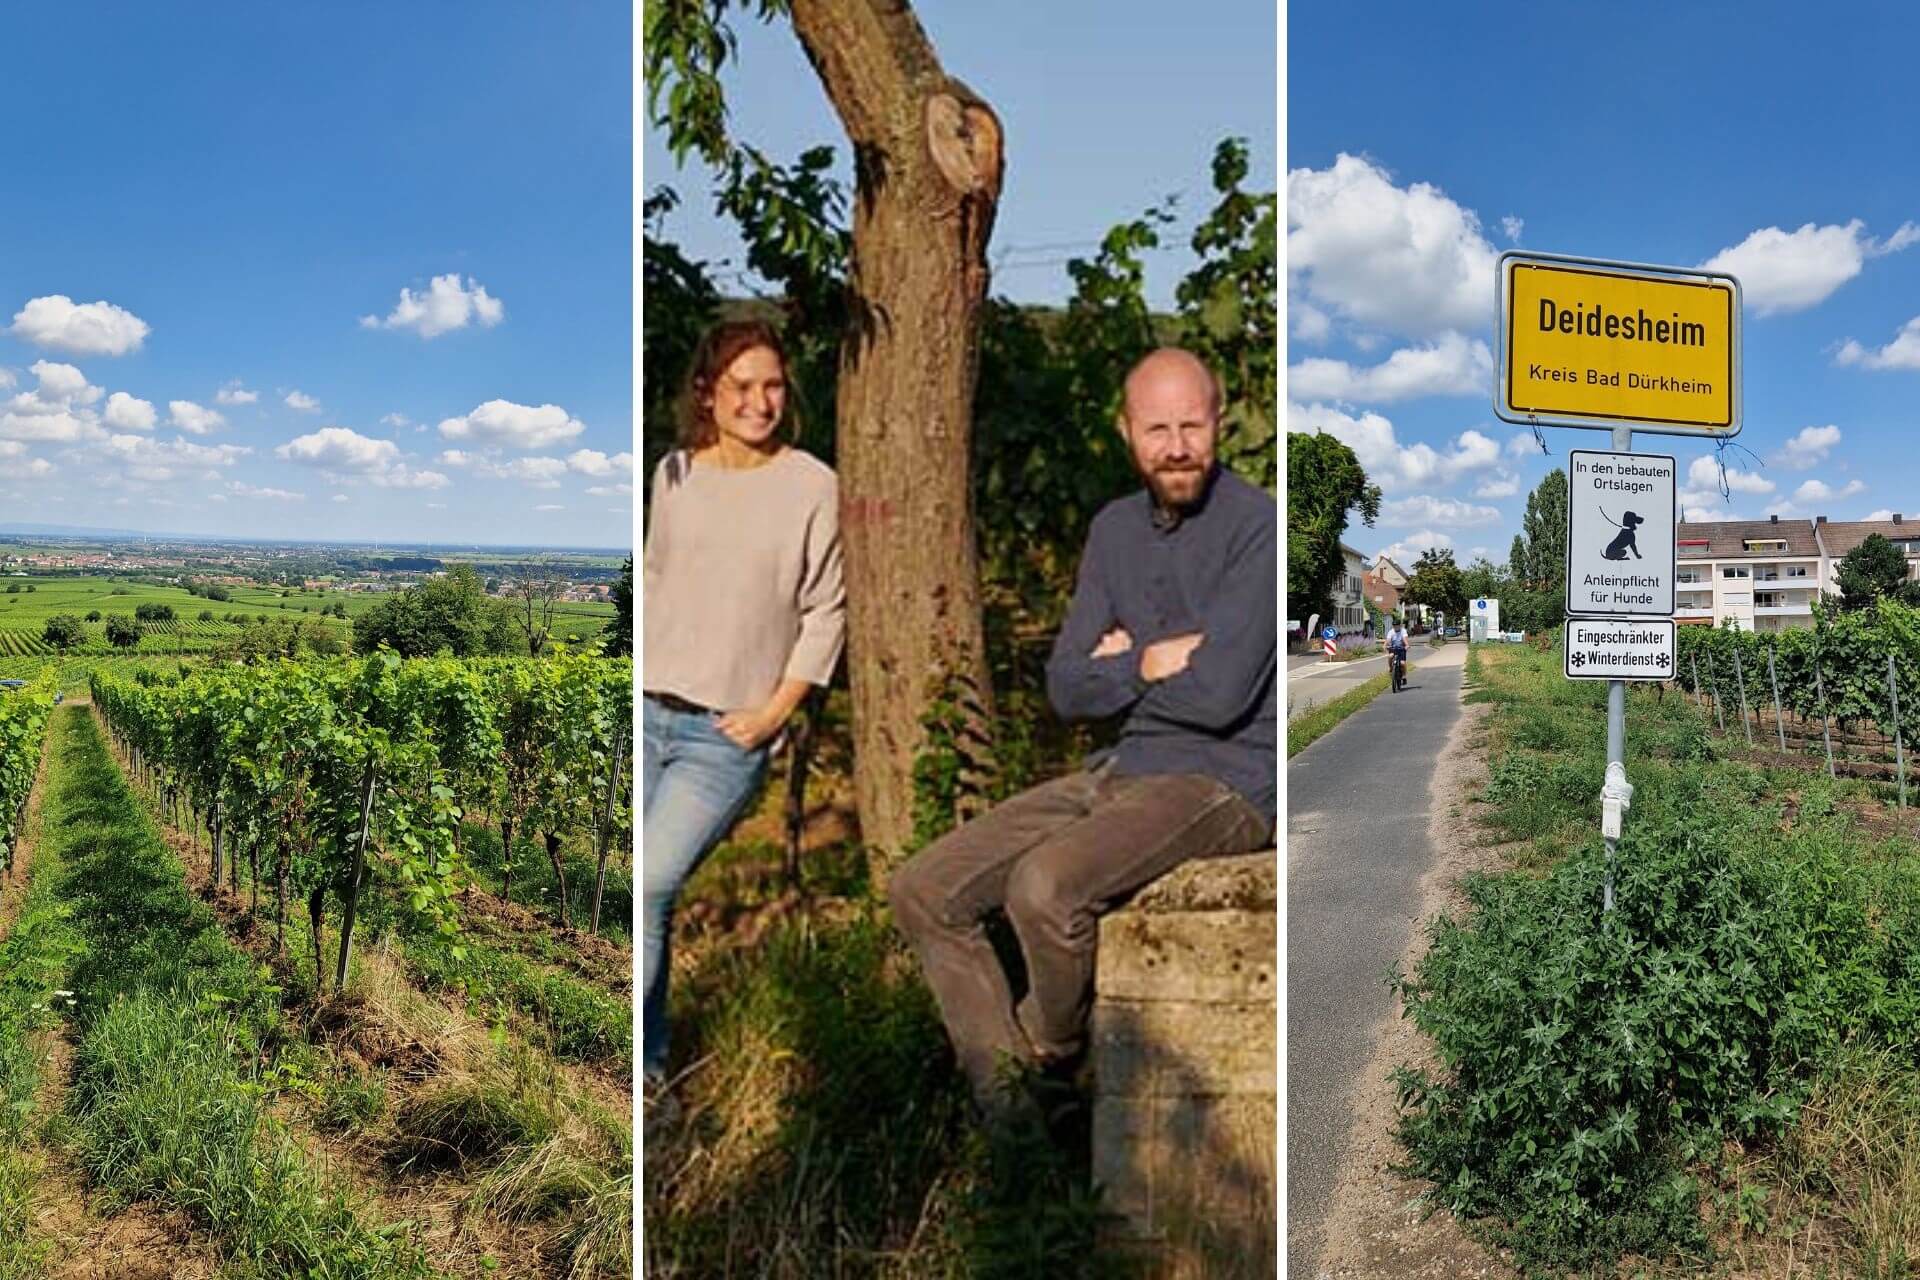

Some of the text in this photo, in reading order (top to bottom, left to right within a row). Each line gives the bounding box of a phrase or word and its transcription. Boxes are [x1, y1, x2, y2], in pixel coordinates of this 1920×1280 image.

[1539, 298, 1705, 347] Deidesheim
[1529, 364, 1712, 395] Kreis Bad Dürkheim
[1576, 461, 1670, 478] In den bebauten
[1593, 478, 1653, 494] Ortslagen
[1584, 574, 1659, 589] Anleinpflicht
[1591, 591, 1653, 604] für Hunde
[1577, 629, 1664, 647] Eingeschränkter
[1587, 650, 1655, 667] Winterdienst
